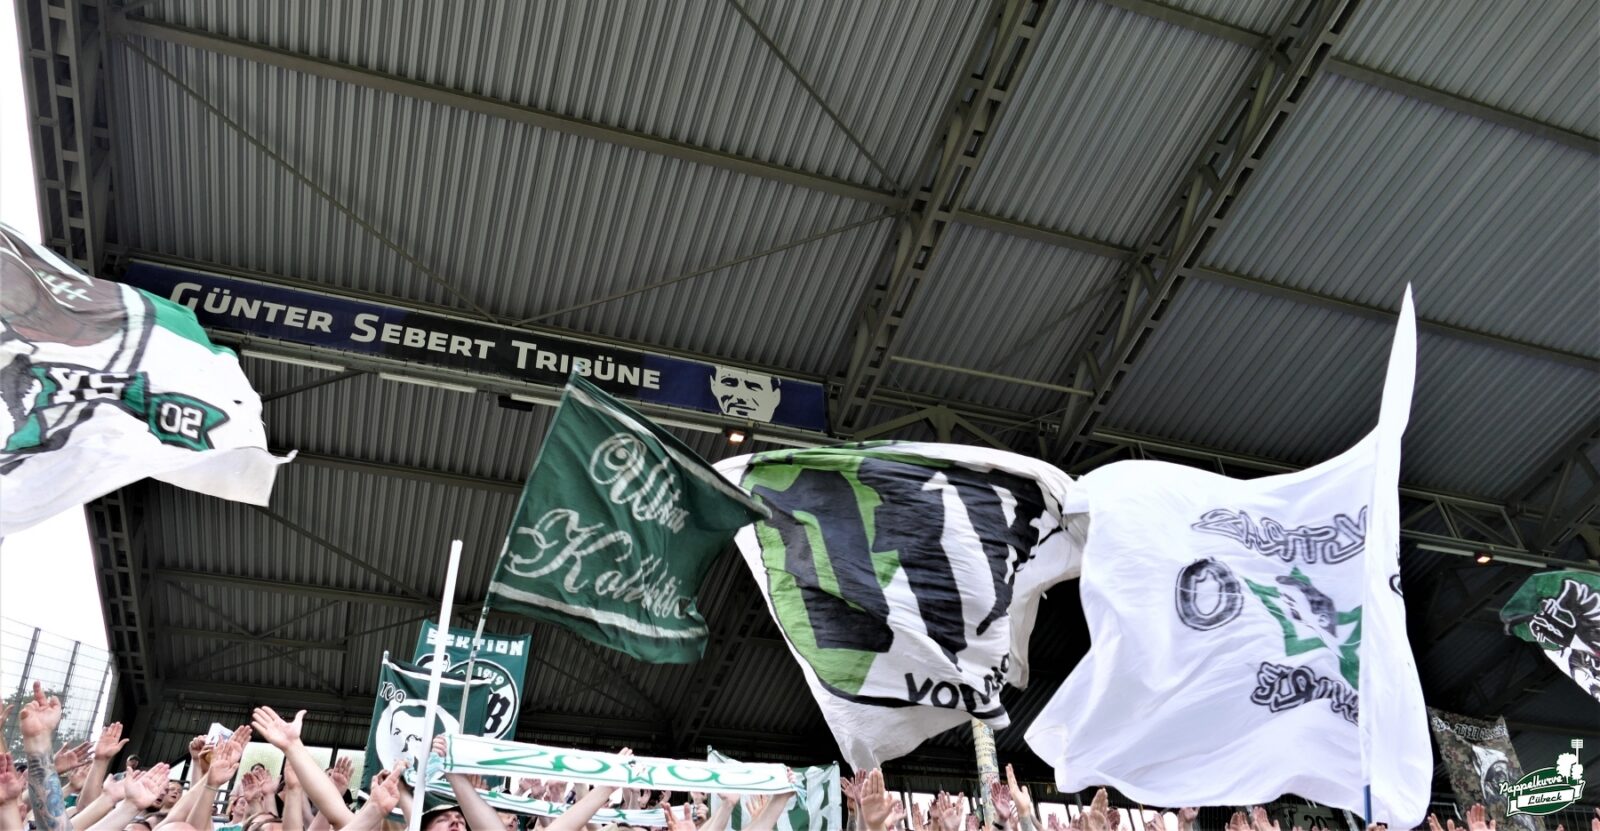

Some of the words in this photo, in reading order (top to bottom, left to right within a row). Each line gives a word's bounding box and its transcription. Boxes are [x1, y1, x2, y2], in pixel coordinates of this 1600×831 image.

[170, 281, 333, 333] GÜNTER
[350, 312, 496, 359] SEBERT
[511, 340, 661, 390] TRIBÜNE
